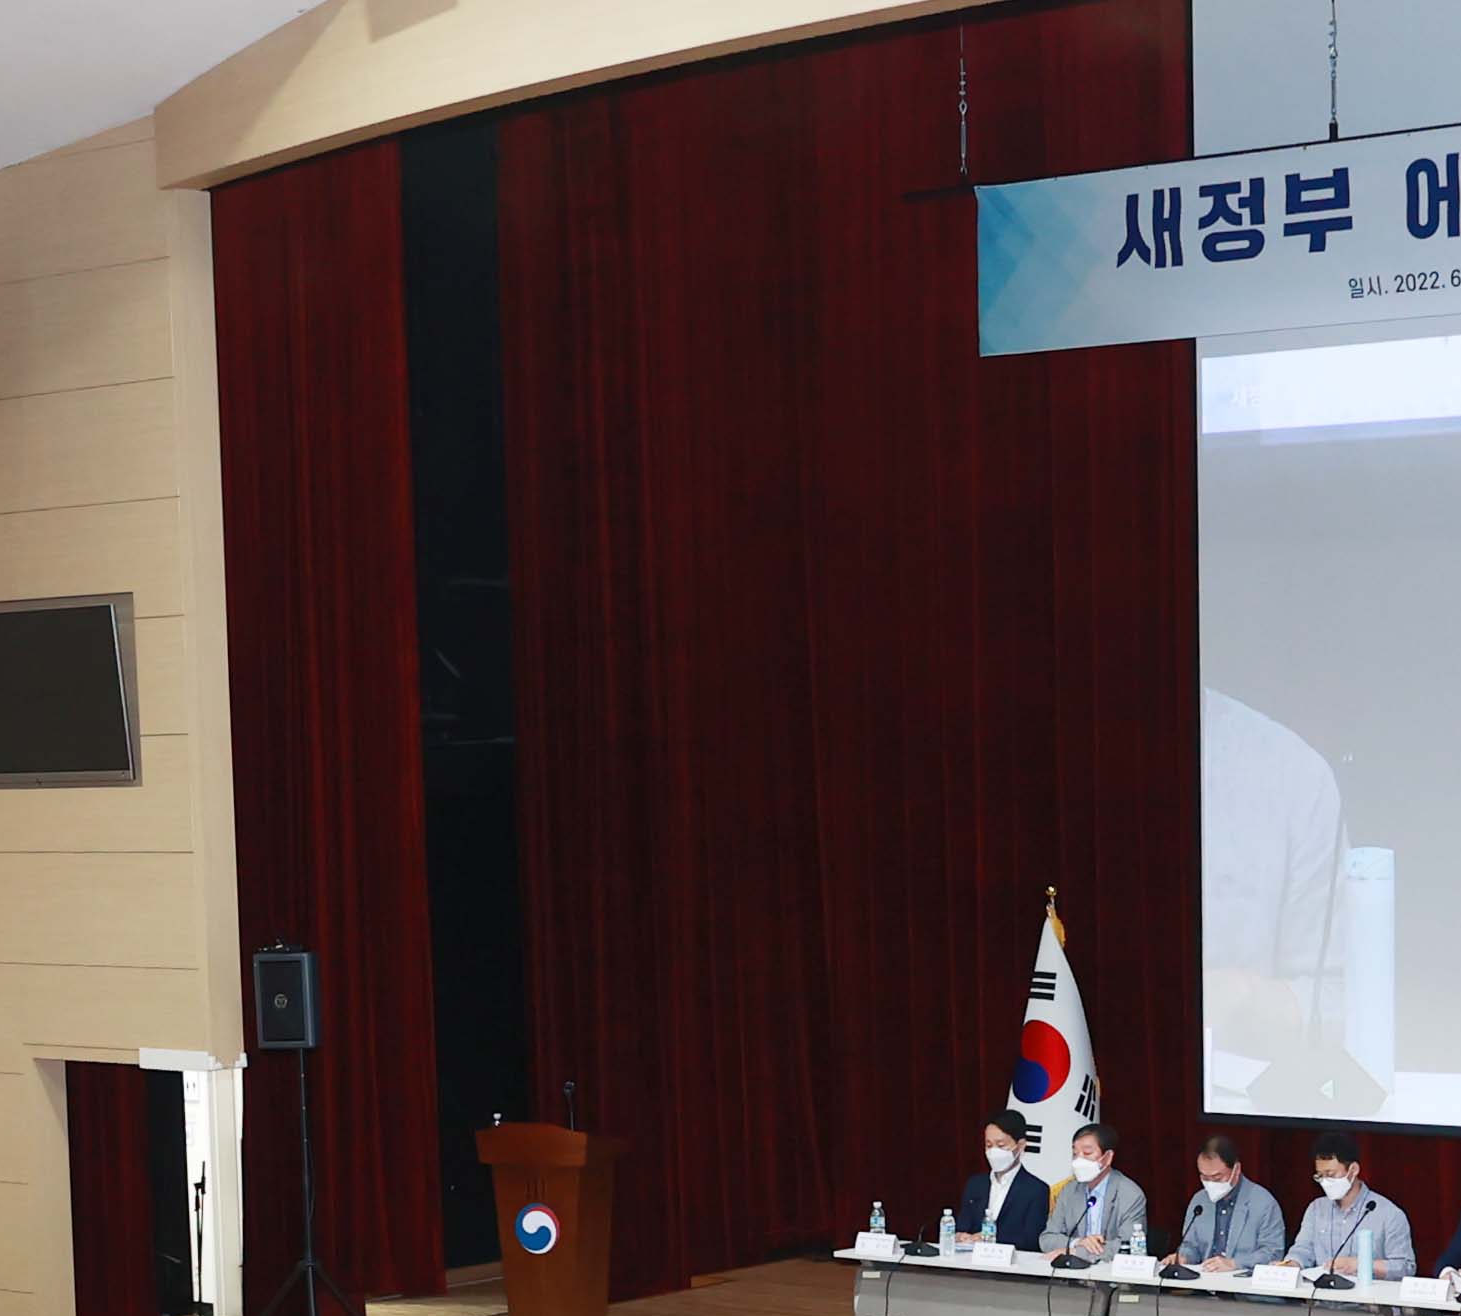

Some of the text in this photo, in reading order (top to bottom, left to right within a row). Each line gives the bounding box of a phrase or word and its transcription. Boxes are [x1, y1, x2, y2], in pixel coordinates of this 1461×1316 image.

[1116, 166, 1353, 269] 새정부
[1347, 275, 1389, 299] 일시.
[1394, 270, 1446, 295] 2022.
